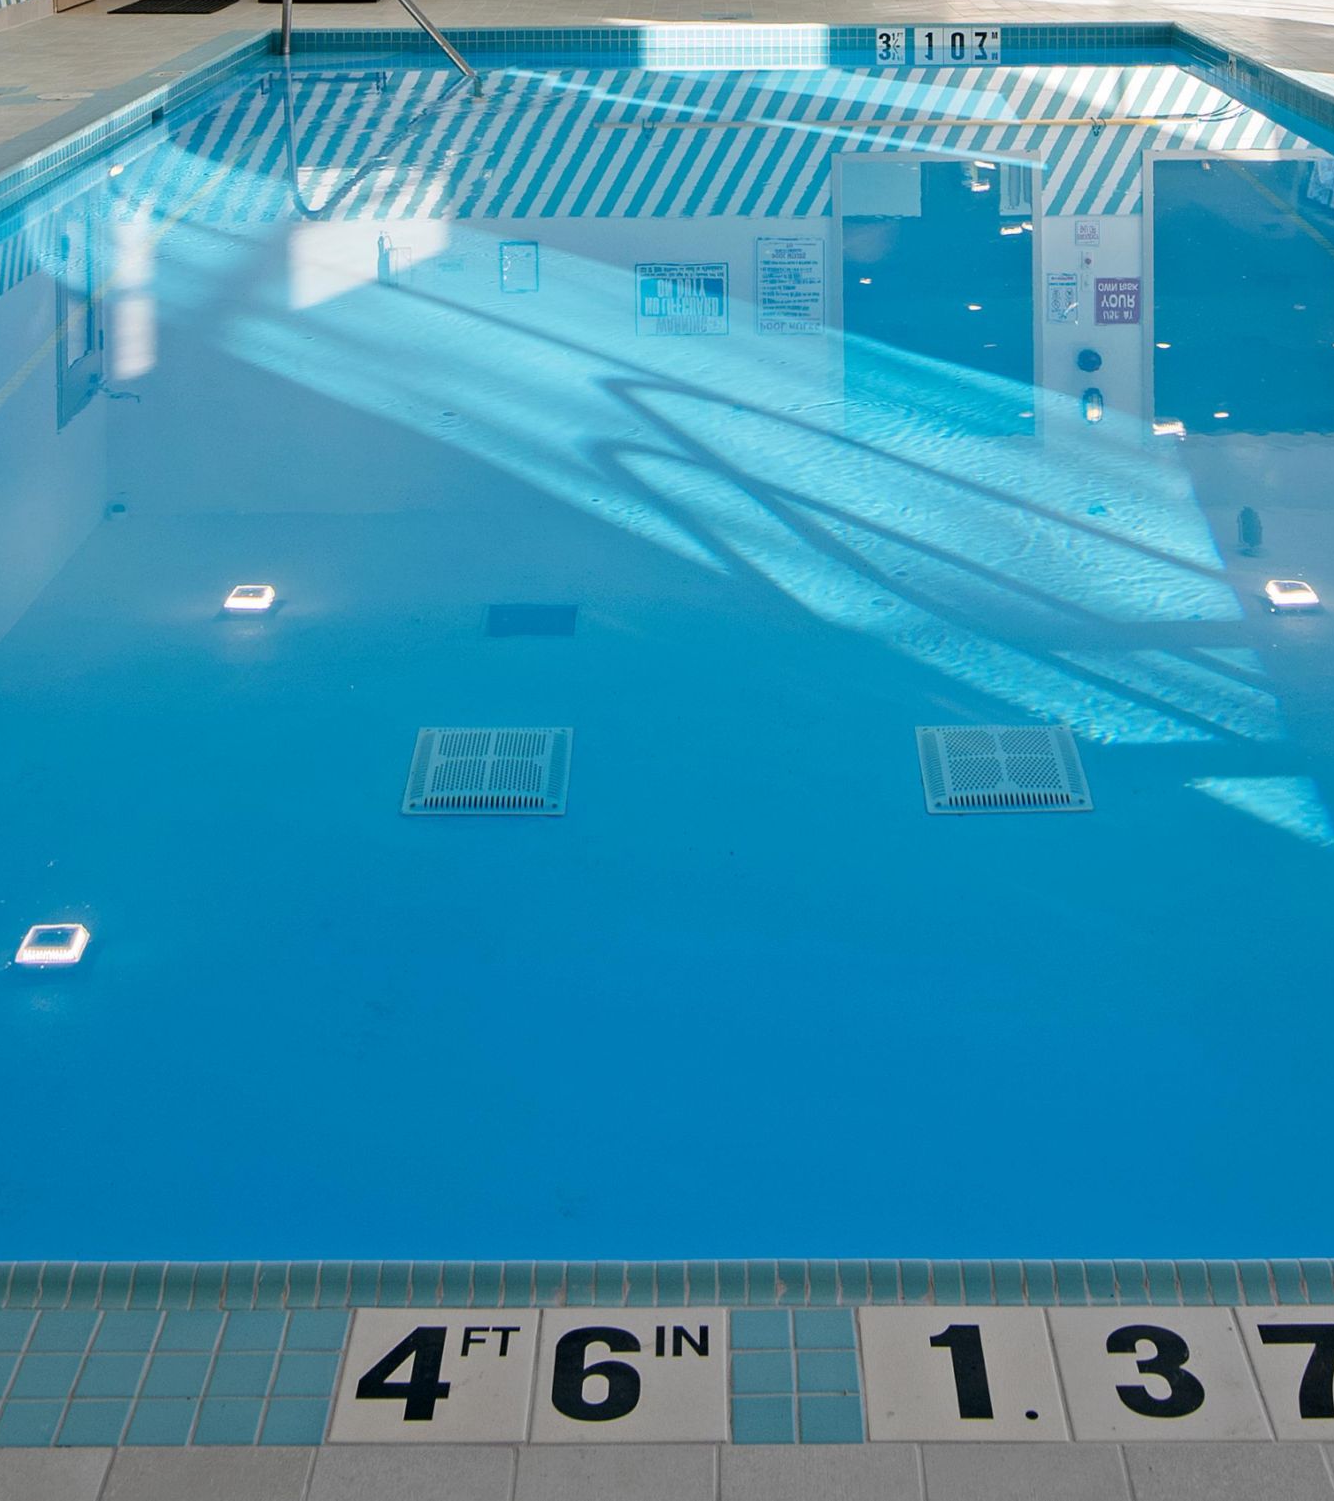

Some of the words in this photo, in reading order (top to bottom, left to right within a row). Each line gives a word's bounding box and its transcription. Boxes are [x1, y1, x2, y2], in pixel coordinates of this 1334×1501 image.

[355, 1326, 451, 1421] 4
[460, 1326, 521, 1357] FT
[551, 1325, 641, 1422] 6
[655, 1325, 710, 1357] IN
